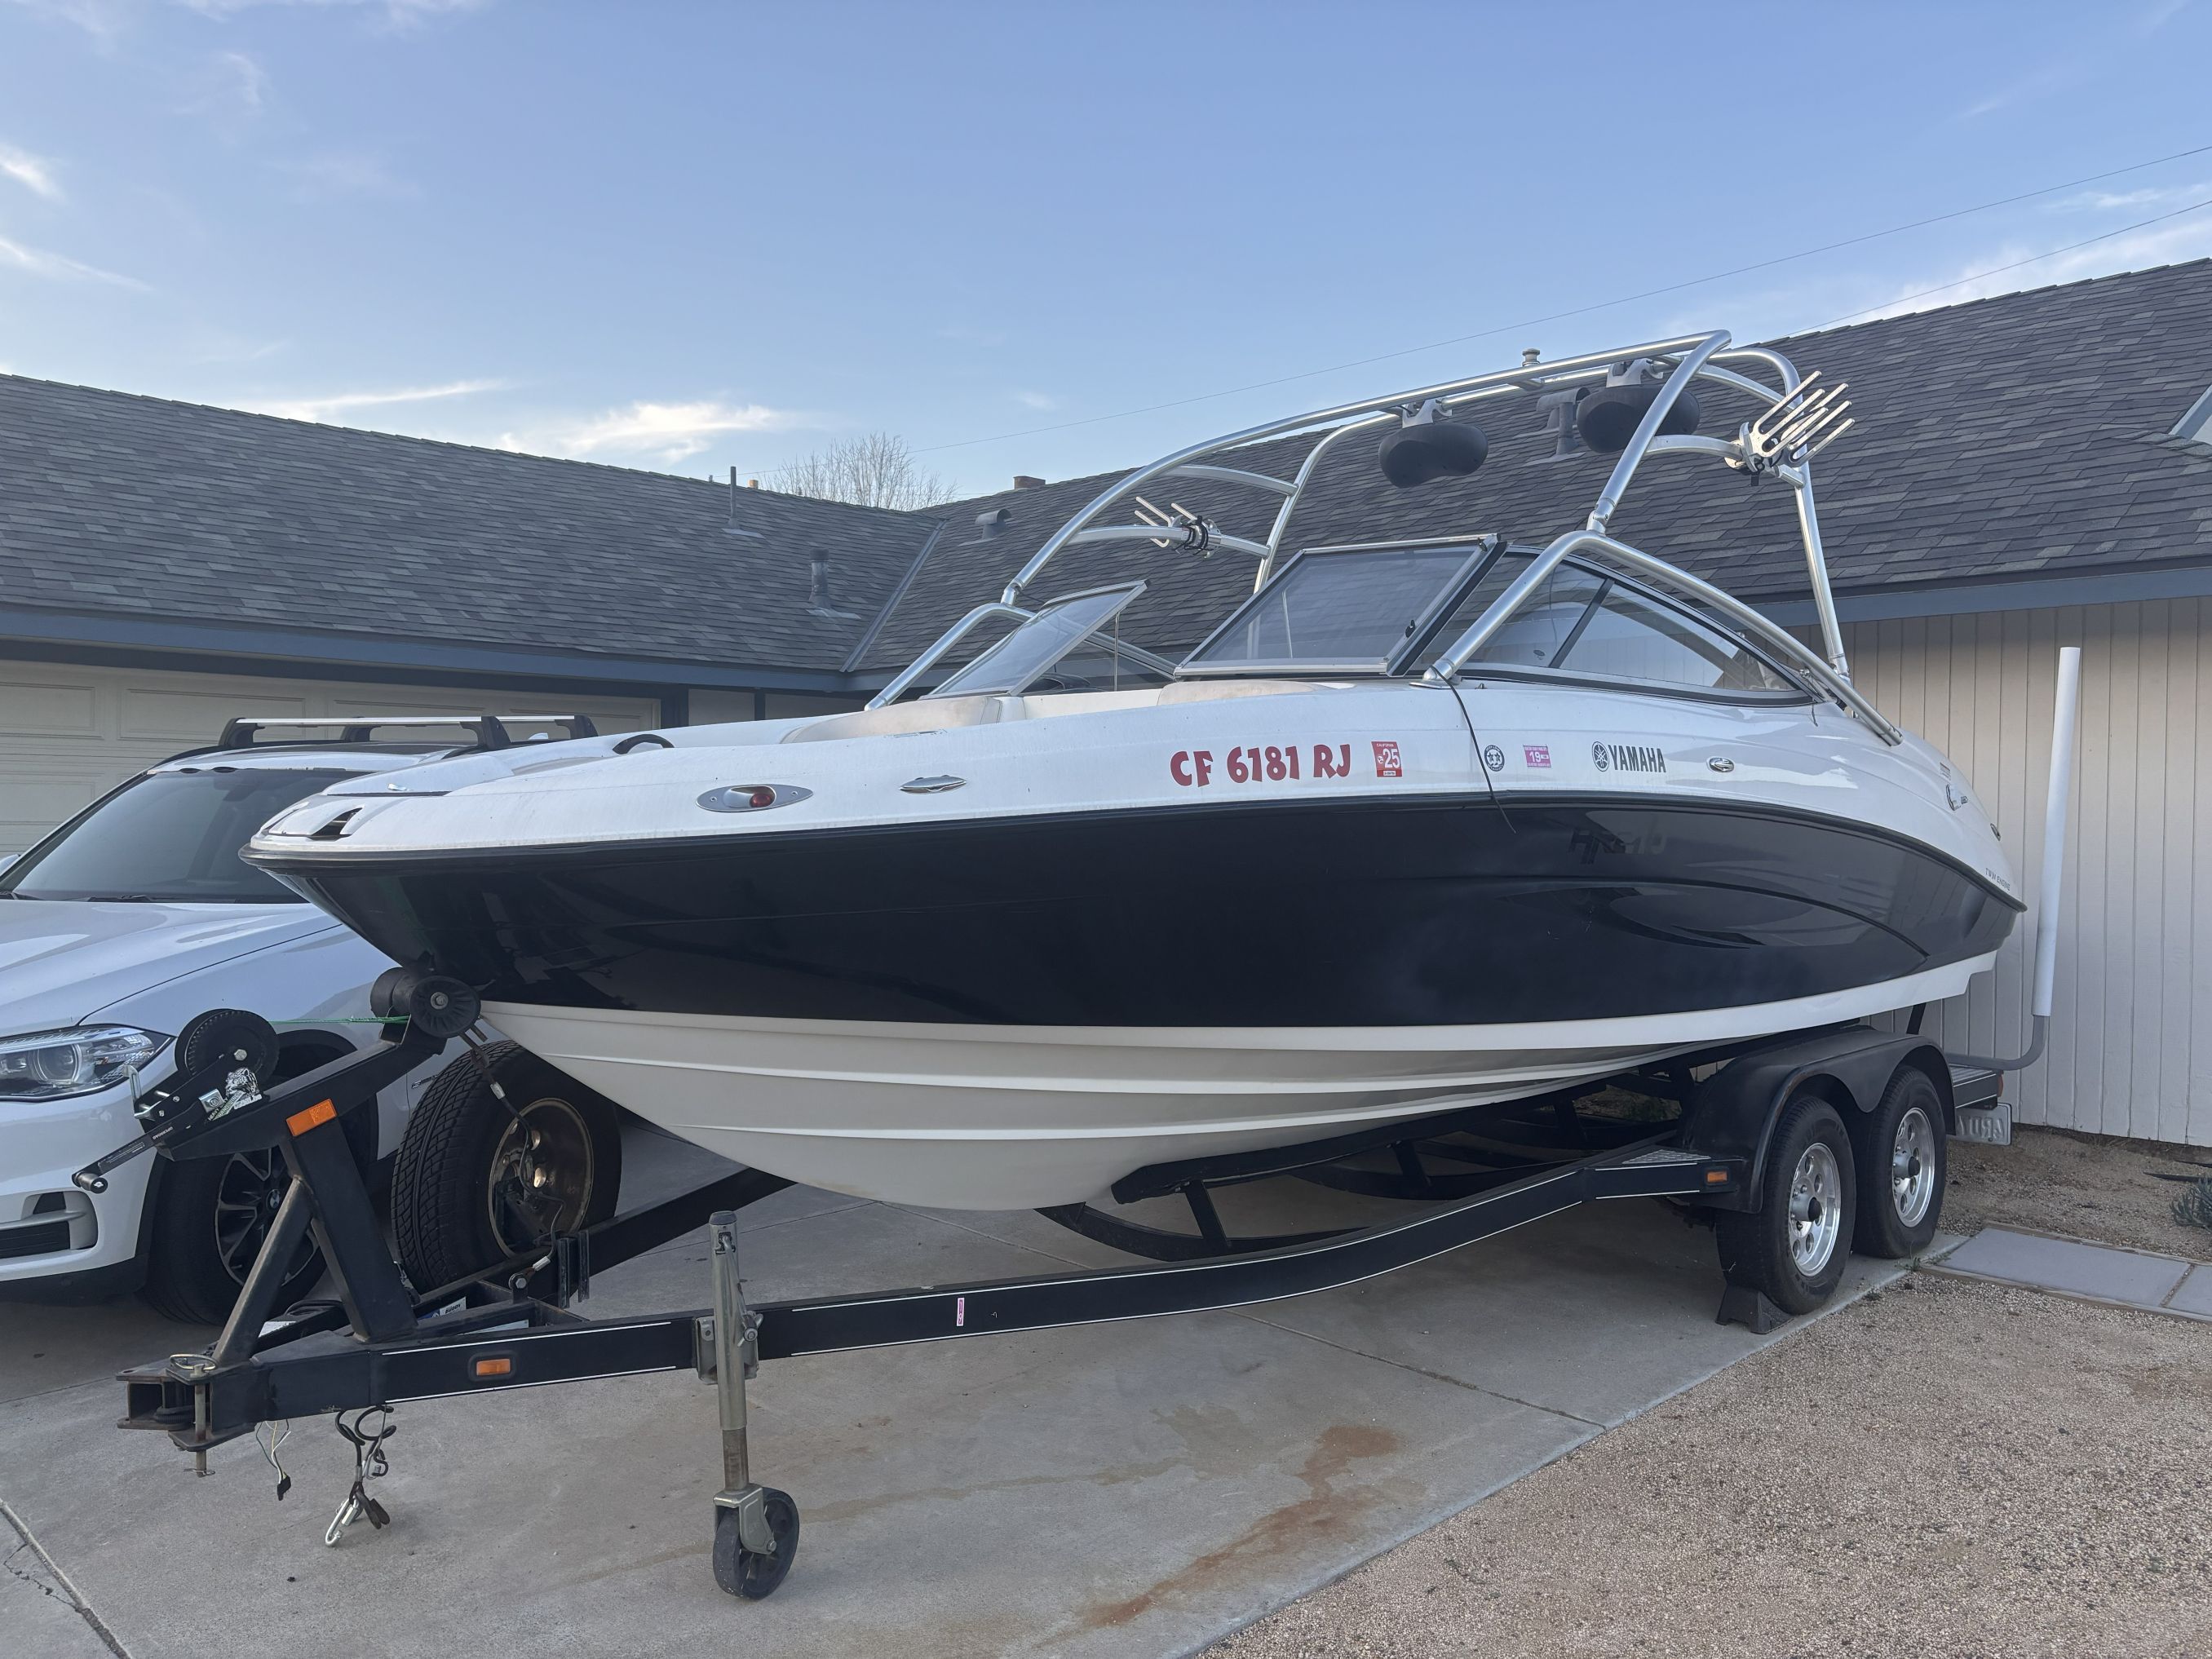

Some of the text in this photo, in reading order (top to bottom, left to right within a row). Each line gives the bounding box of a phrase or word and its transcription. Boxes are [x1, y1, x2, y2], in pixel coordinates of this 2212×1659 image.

[1170, 743, 1351, 788] CF 6181 RJ
[1382, 748, 1400, 768] 25
[1529, 751, 1542, 763] 19
[1608, 744, 1667, 773] YAMAHA
